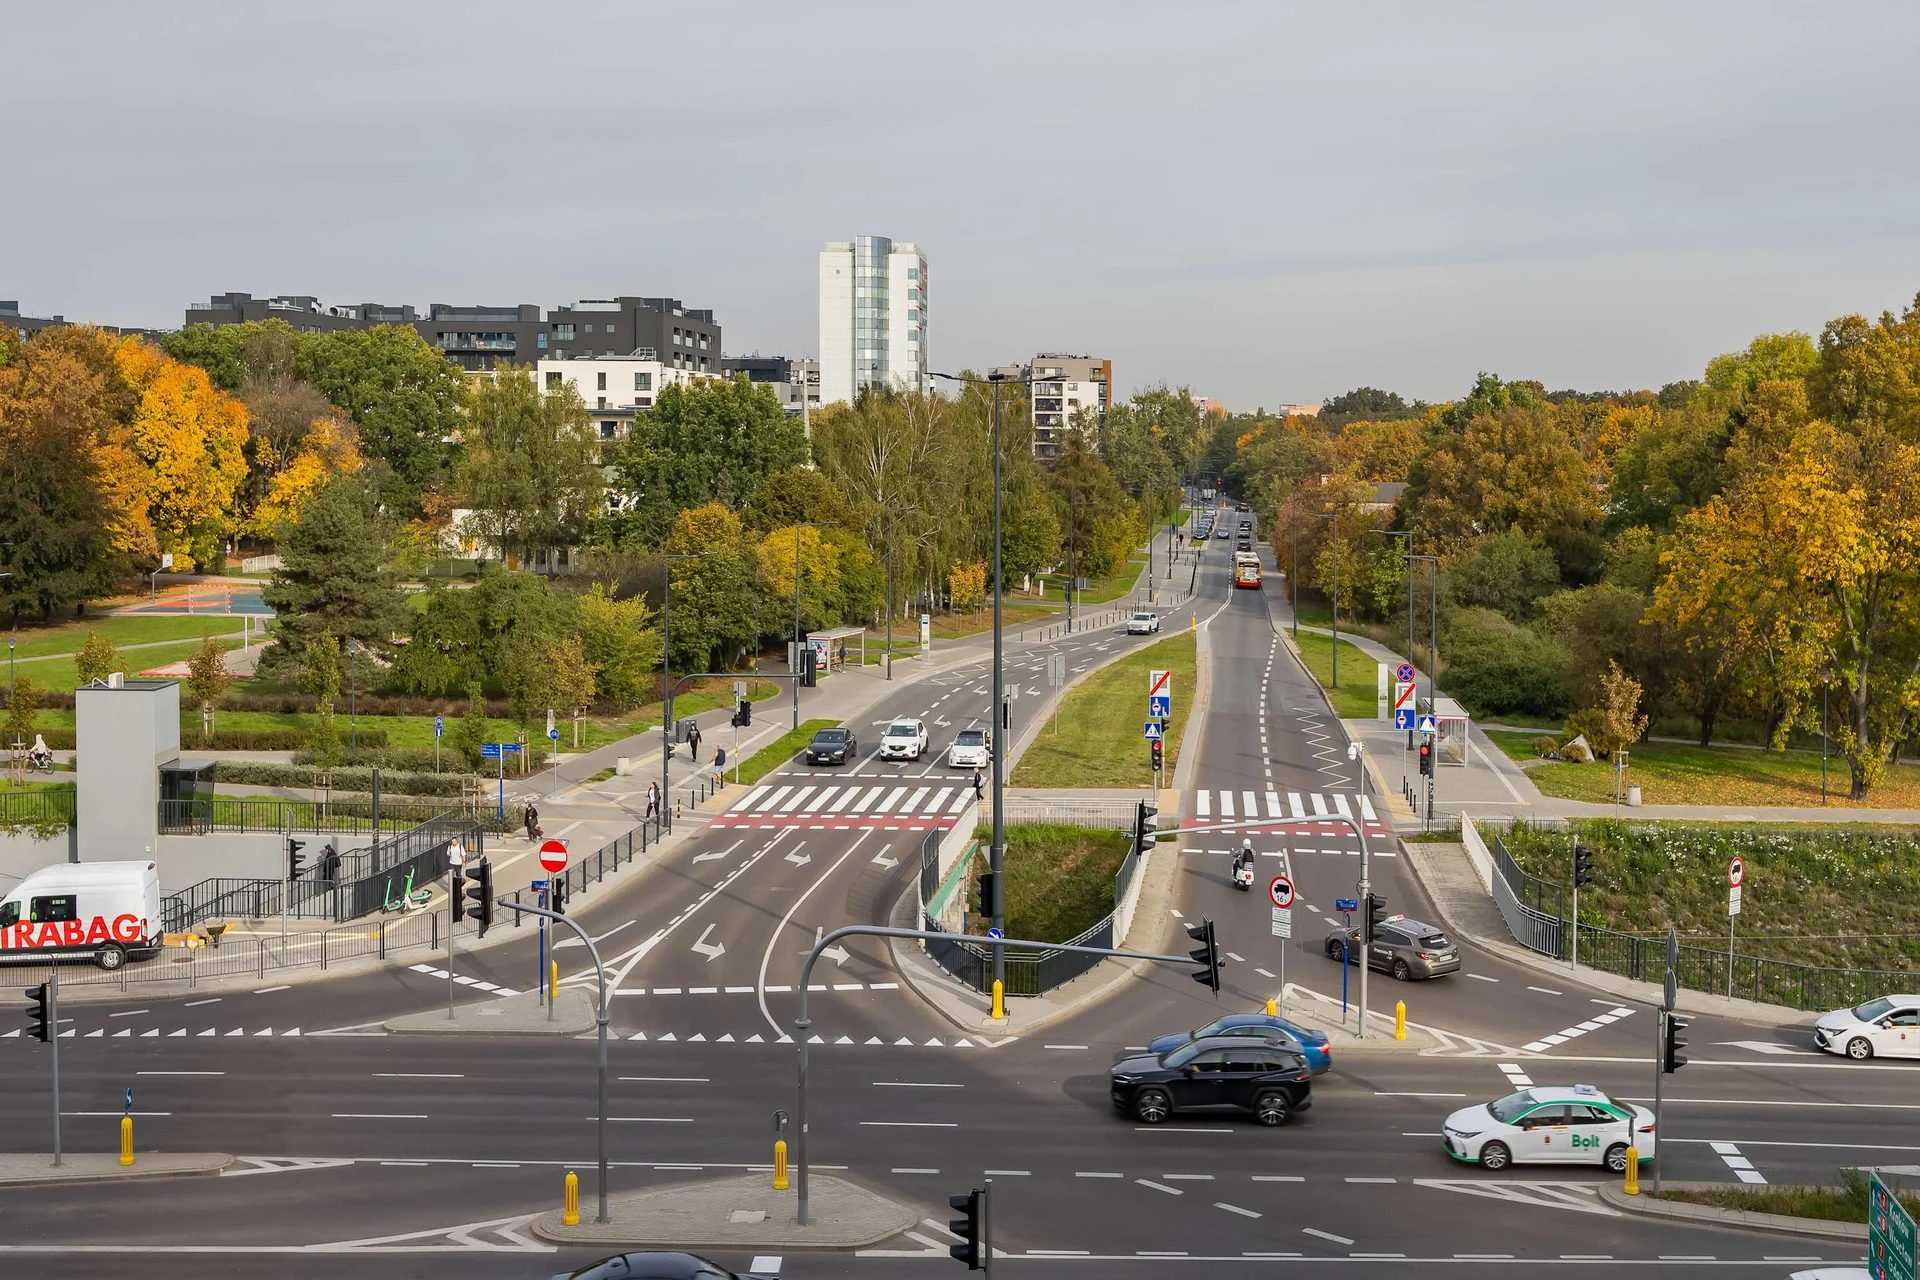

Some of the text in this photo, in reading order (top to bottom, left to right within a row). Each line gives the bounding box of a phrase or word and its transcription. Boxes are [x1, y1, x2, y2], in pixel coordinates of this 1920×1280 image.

[1277, 895, 1284, 903] 16
[1572, 1134, 1600, 1148] Bolt
[1889, 1201, 1909, 1239] Kraków
[1889, 1225, 1912, 1268] Wrocław
